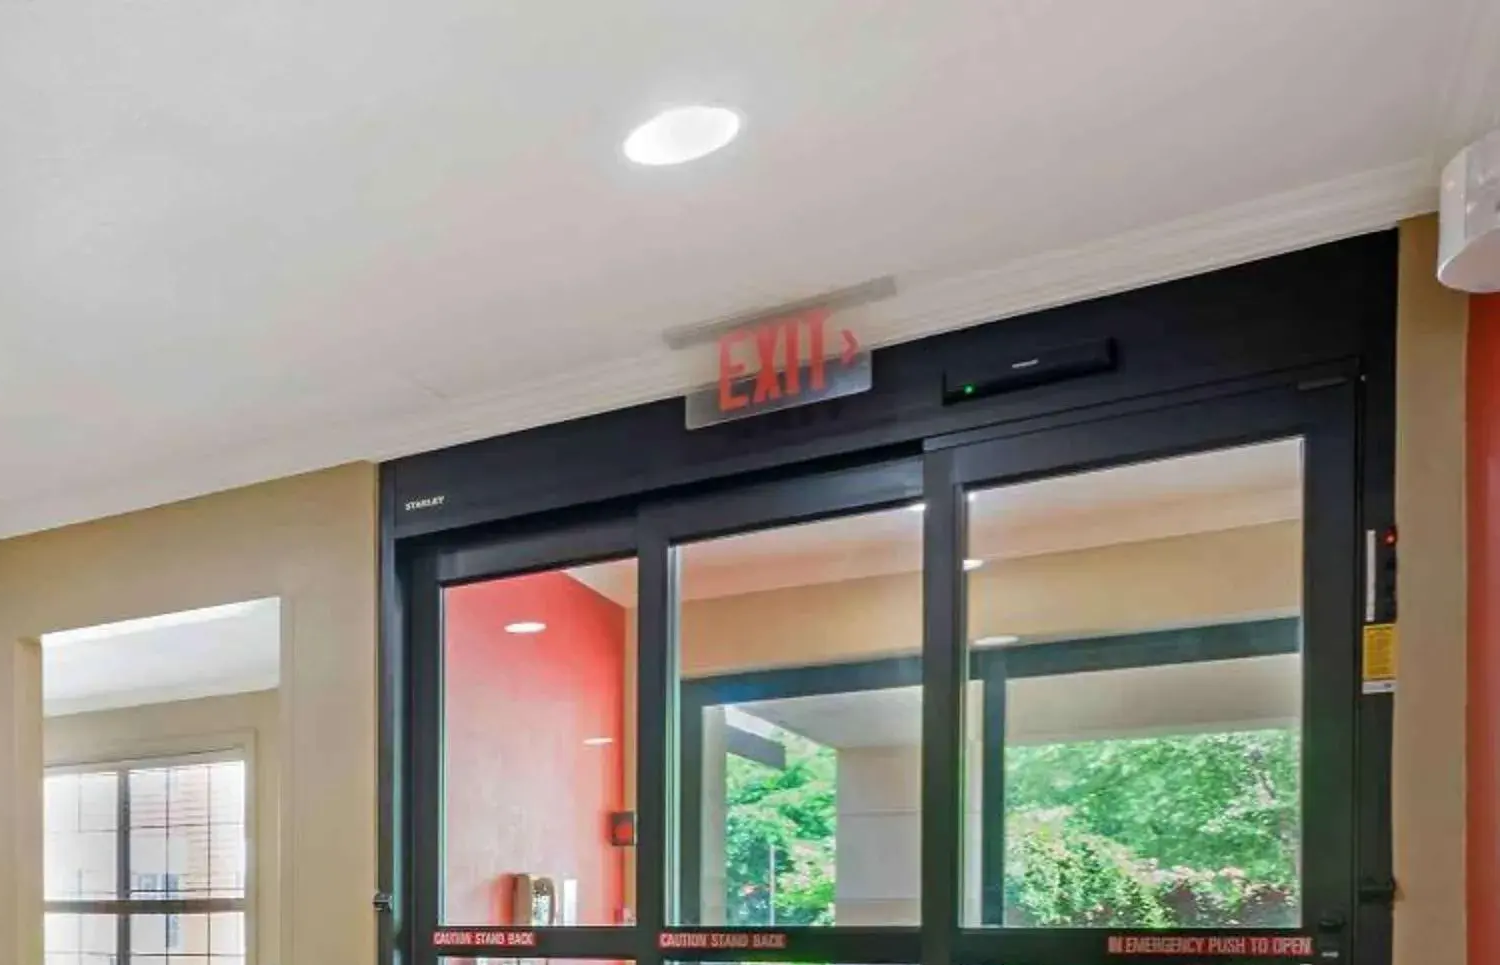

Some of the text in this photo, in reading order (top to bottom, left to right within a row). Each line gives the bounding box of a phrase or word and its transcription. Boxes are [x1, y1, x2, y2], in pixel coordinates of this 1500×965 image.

[718, 306, 832, 413] EXIT
[433, 931, 472, 945] CAUTION
[475, 931, 505, 945] STAND
[660, 933, 707, 948] CAUTION
[711, 933, 749, 948] STAND
[1125, 936, 1205, 953] EMERGENCY
[1208, 936, 1245, 953] PUSH
[1251, 936, 1267, 954] TO
[1273, 936, 1312, 954] OPEN
